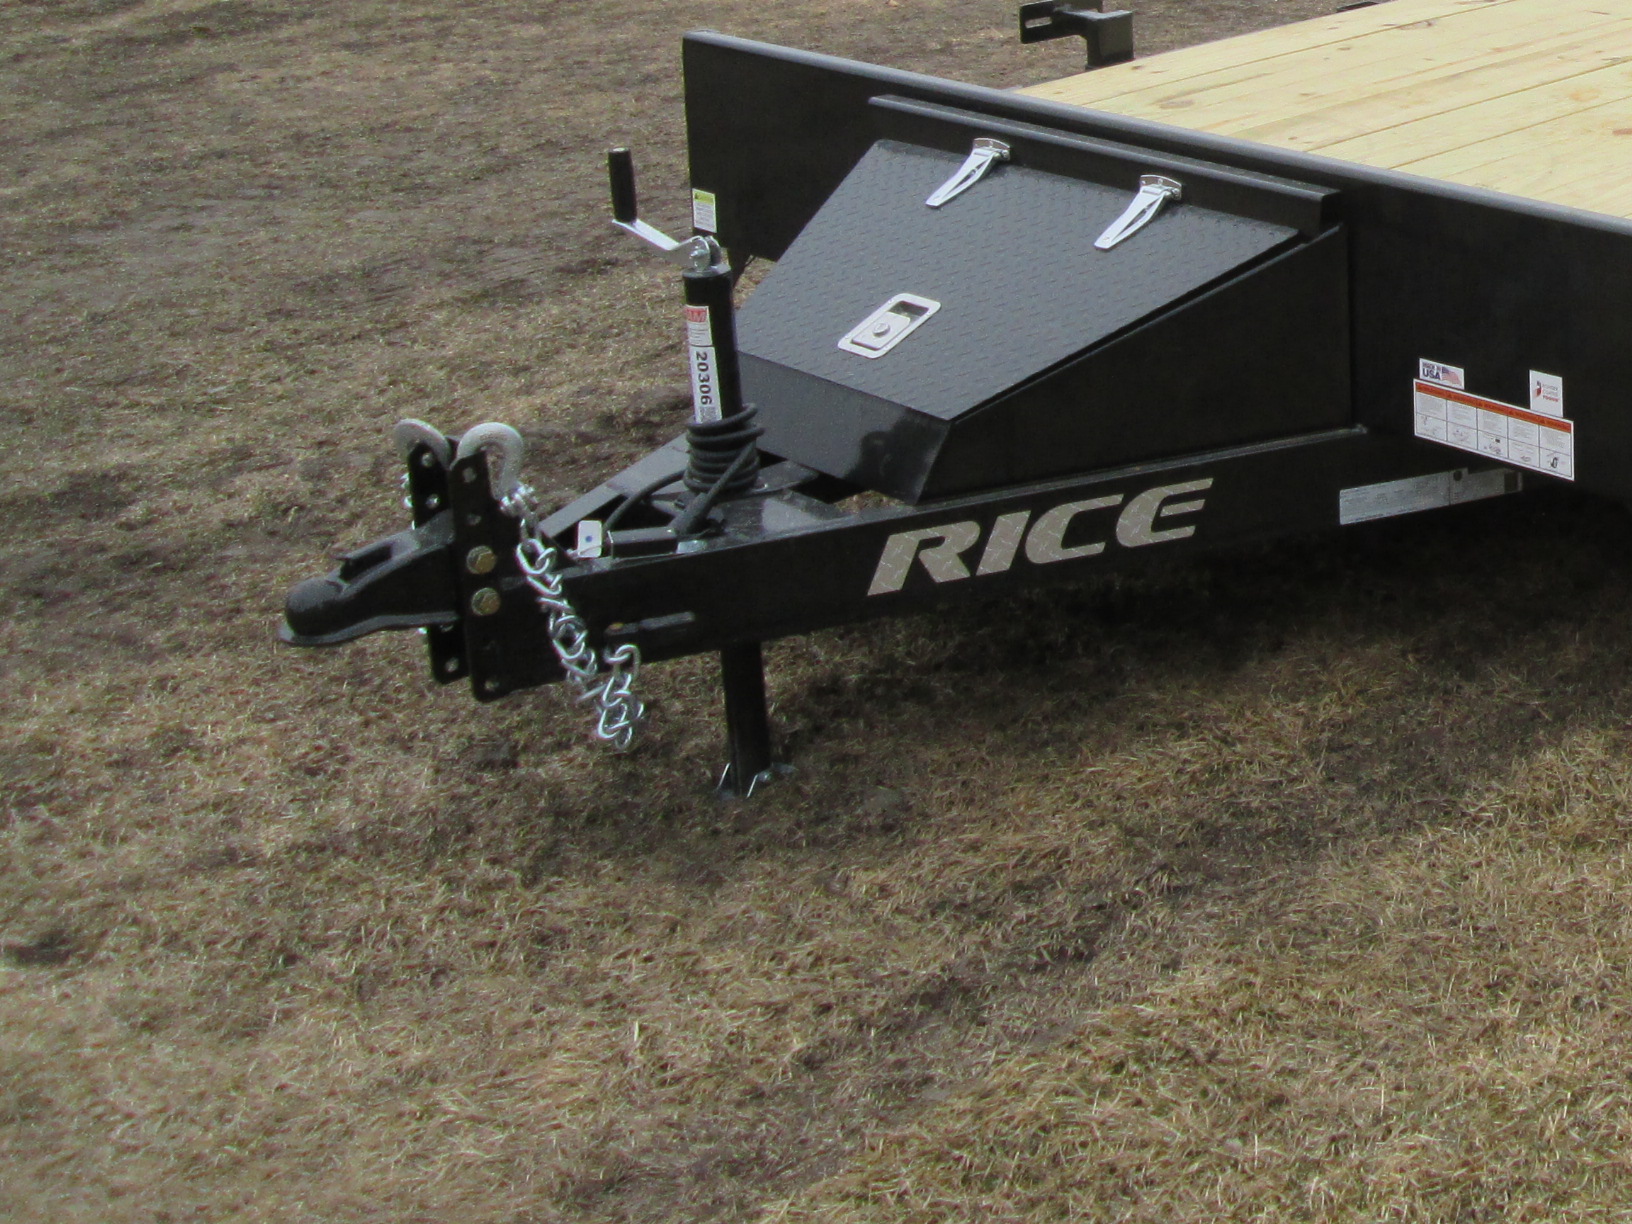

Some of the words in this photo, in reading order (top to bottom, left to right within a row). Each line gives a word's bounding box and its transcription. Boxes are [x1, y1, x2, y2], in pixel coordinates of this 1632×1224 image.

[696, 351, 713, 406] 20306
[1422, 368, 1442, 381] USA
[867, 477, 1214, 596] RICE
